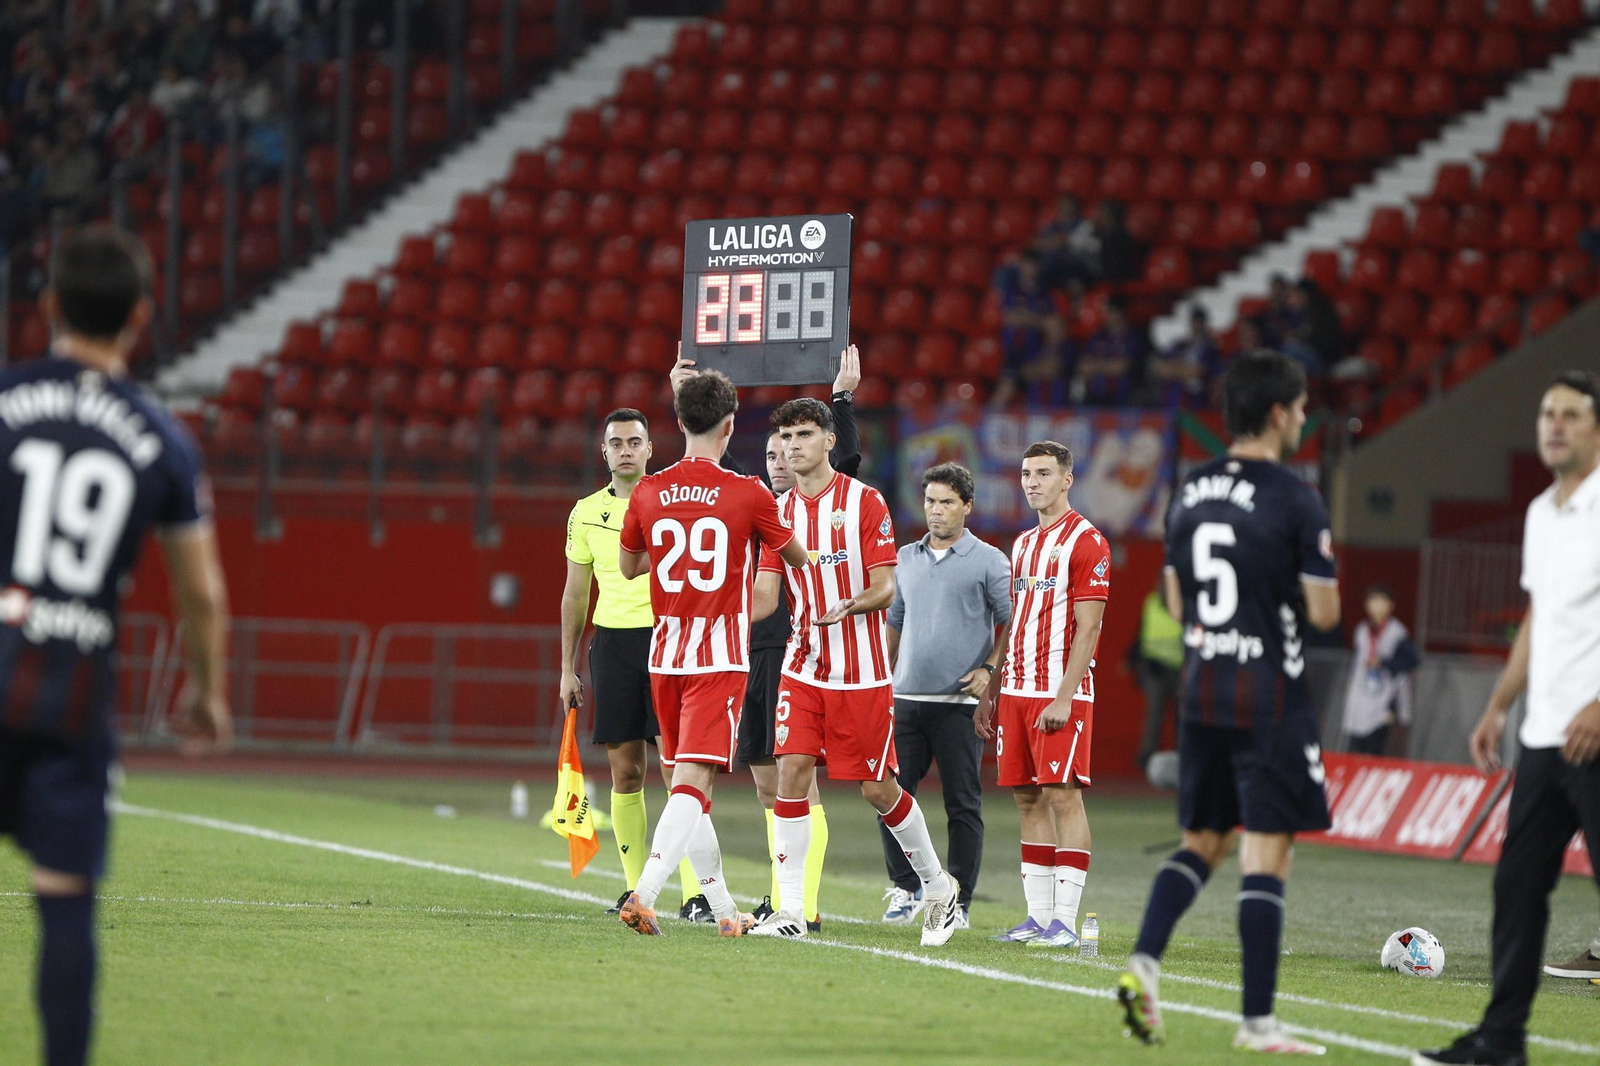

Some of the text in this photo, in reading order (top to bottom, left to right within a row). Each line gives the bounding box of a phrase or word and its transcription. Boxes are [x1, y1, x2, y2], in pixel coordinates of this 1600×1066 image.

[709, 224, 794, 251] LALIGA
[806, 227, 820, 236] EA
[659, 483, 721, 507] DŽODIĆ
[1182, 474, 1235, 510] JAVI
[10, 437, 137, 598] 19
[651, 516, 729, 593] 29
[1192, 521, 1240, 628] 5
